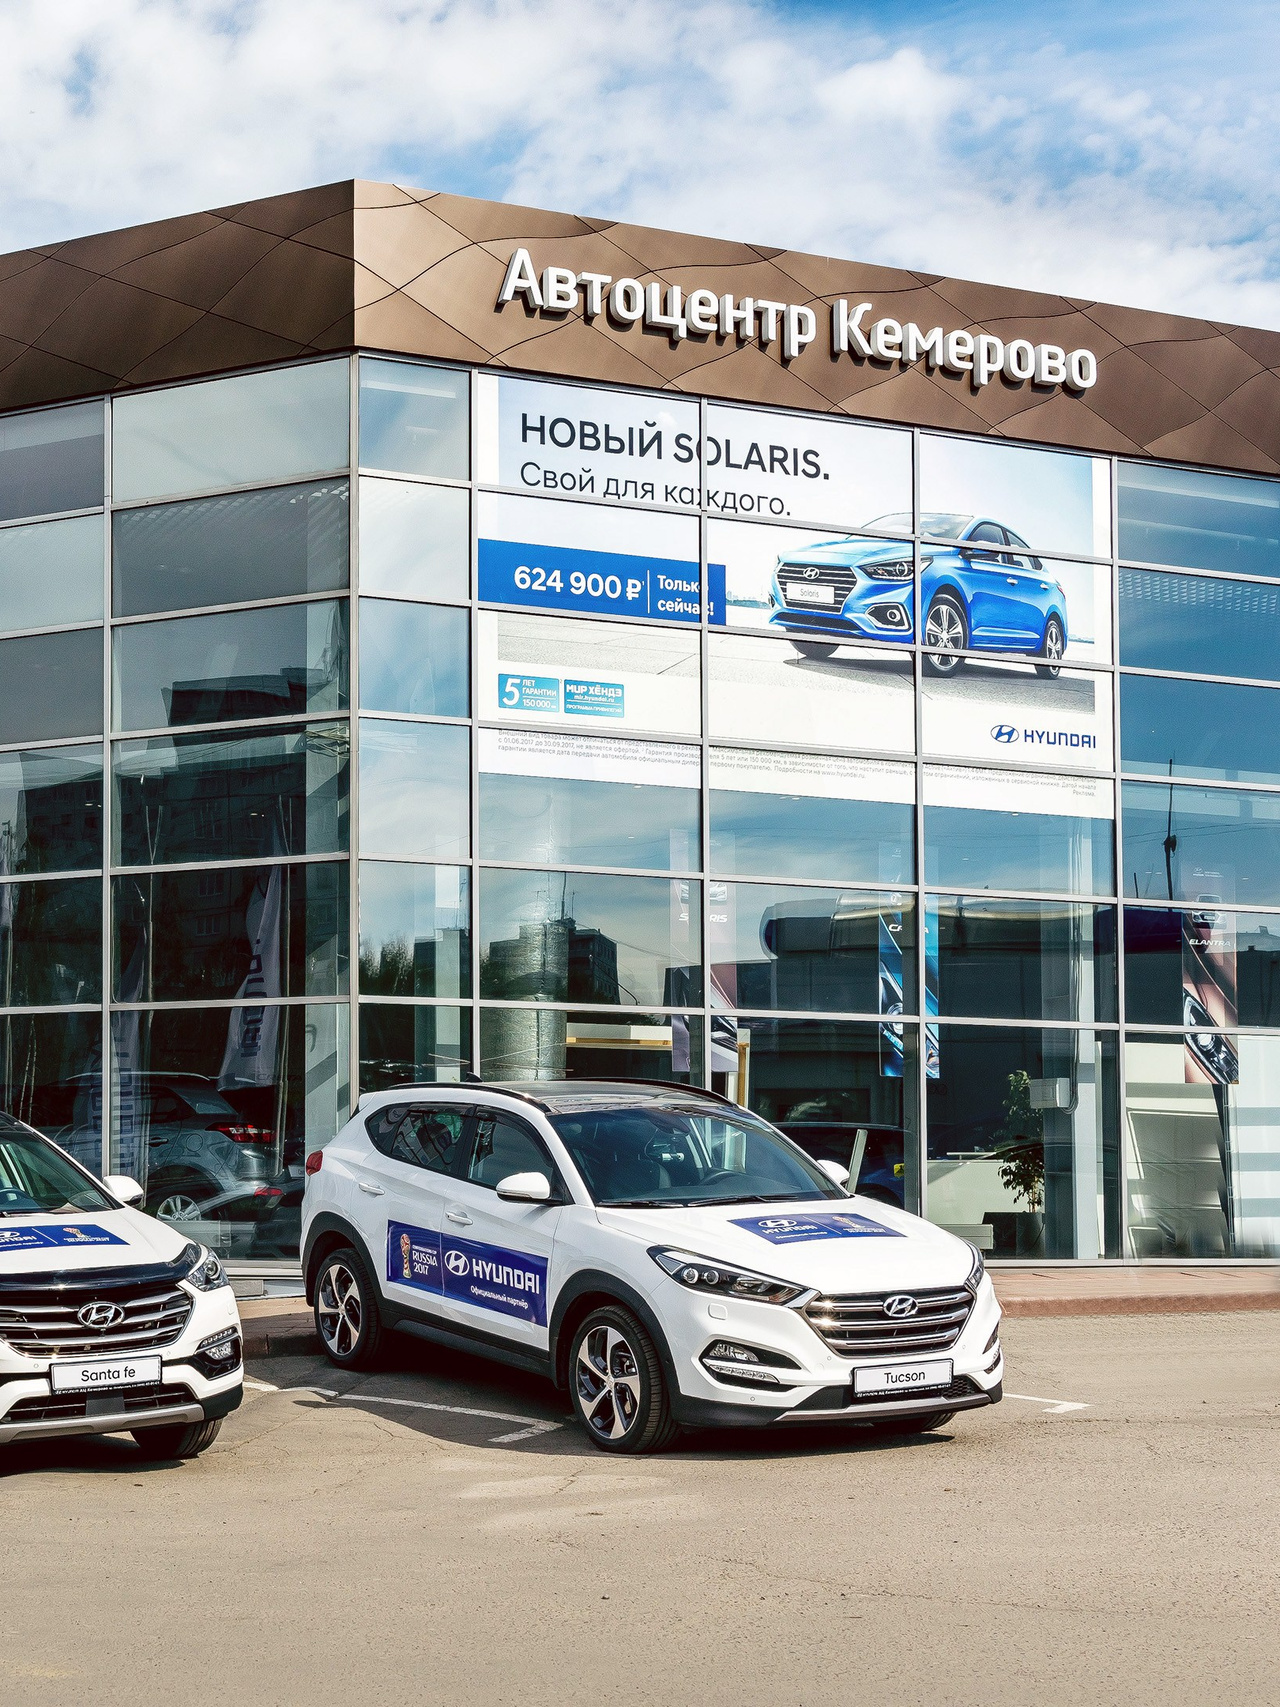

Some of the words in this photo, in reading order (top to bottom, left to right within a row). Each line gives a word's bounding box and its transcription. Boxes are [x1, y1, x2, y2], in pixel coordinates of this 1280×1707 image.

[497, 247, 817, 360] Автоцентр
[832, 299, 1097, 391] Кемерово
[520, 412, 663, 461] НОВЫЙ
[673, 433, 830, 481] SOLARIS.
[520, 461, 595, 496] Свой
[602, 470, 655, 503] для
[664, 484, 791, 516] каждого.
[514, 565, 564, 593] 624
[569, 571, 622, 599] 900
[657, 575, 709, 593] Тольк
[522, 679, 536, 687] ЛЕТ
[588, 685, 623, 697] ХЁНДЭ
[502, 677, 521, 706] 5
[522, 687, 557, 697] ГАРАНТИИ
[523, 699, 535, 708] 150
[535, 699, 551, 709] 000
[1023, 727, 1097, 749] HYUNDAI
[1188, 938, 1231, 947] ELANTRA
[761, 1225, 818, 1234] HYUNDAI
[412, 1250, 438, 1266] RUSSIA
[413, 1262, 429, 1275] 2017
[472, 1258, 540, 1295] HYUNDAI
[470, 1285, 506, 1302] Официальный
[507, 1296, 529, 1310] партнёр
[81, 1368, 120, 1382] Santa
[123, 1366, 136, 1378] fe
[884, 1371, 926, 1384] Tucson
